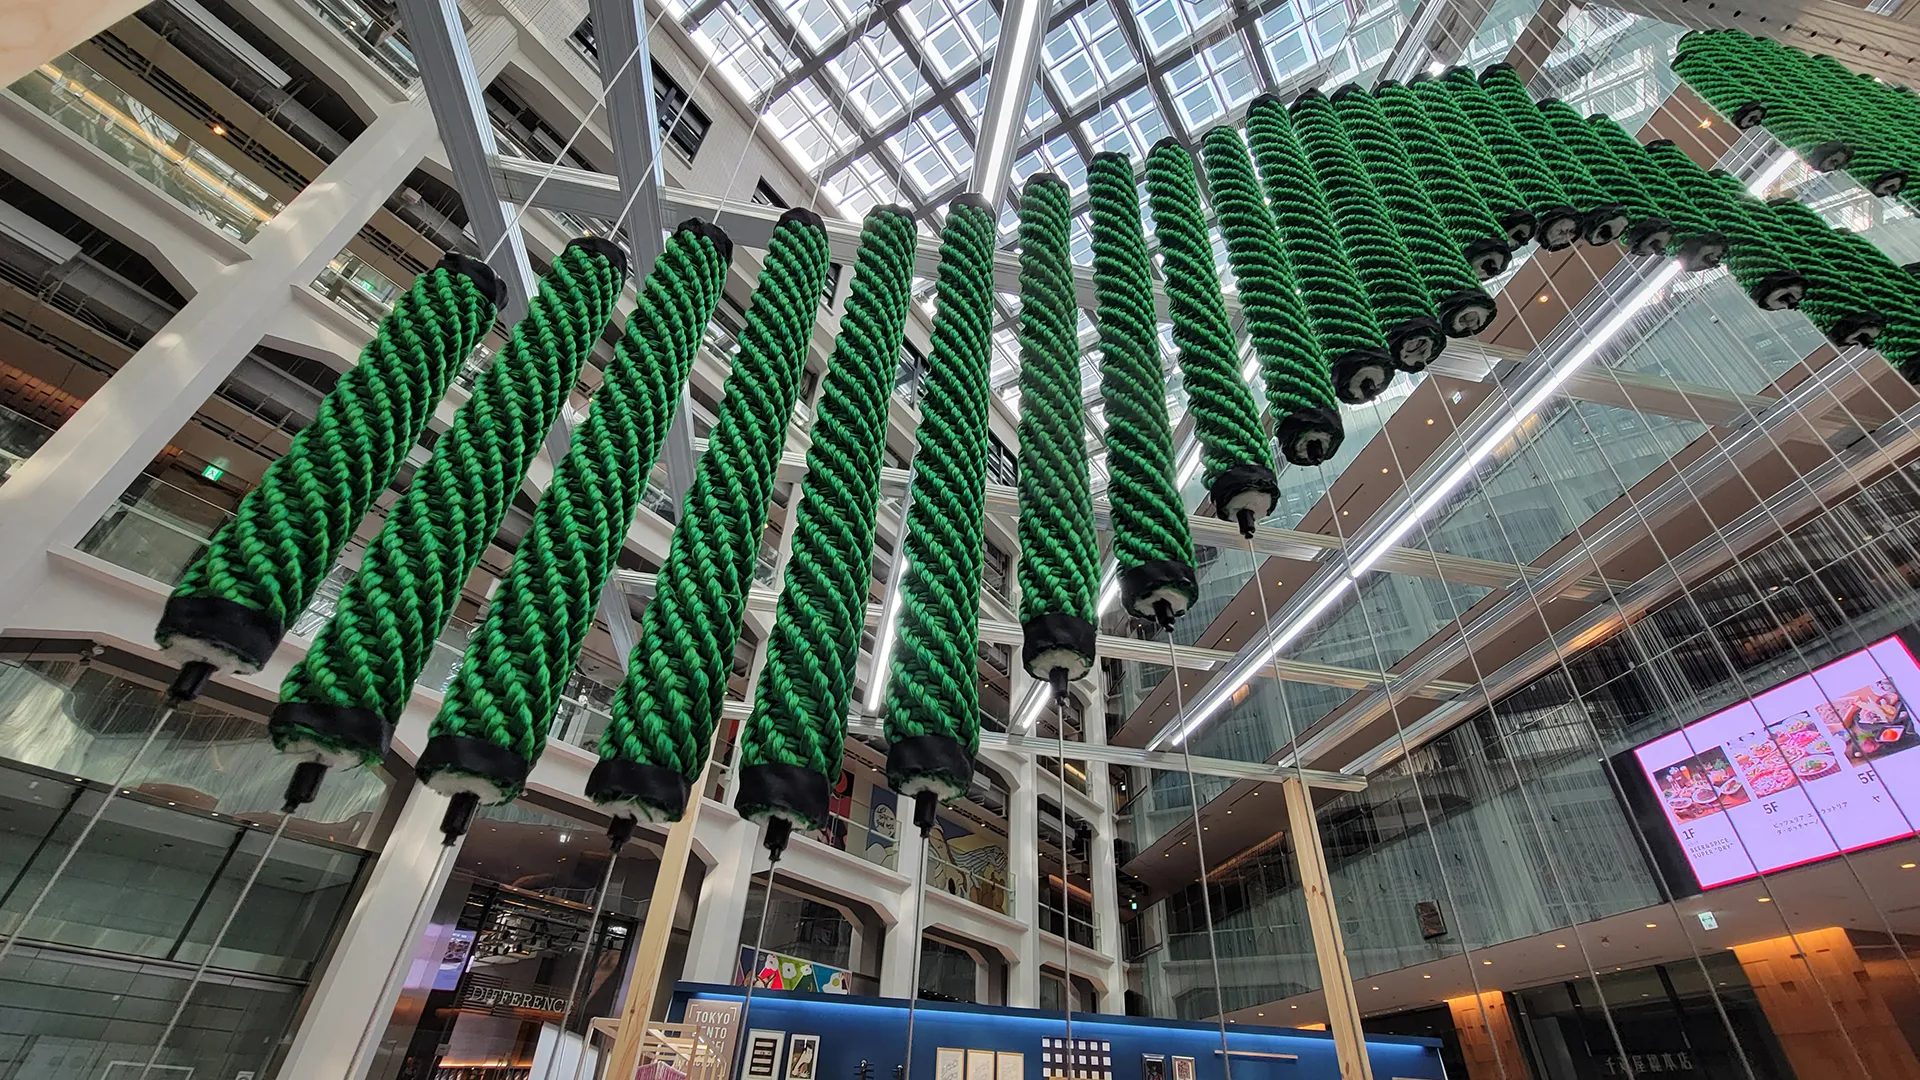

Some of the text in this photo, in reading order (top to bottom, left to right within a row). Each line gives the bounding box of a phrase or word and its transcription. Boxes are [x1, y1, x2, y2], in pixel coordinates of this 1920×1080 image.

[1858, 769, 1876, 785] 5F
[1763, 801, 1779, 815] 5F
[1682, 828, 1696, 840] 1F
[1689, 837, 1730, 854] BEER&SPICE
[1692, 848, 1714, 859] SUPER
[695, 1010, 731, 1025] TOKYO
